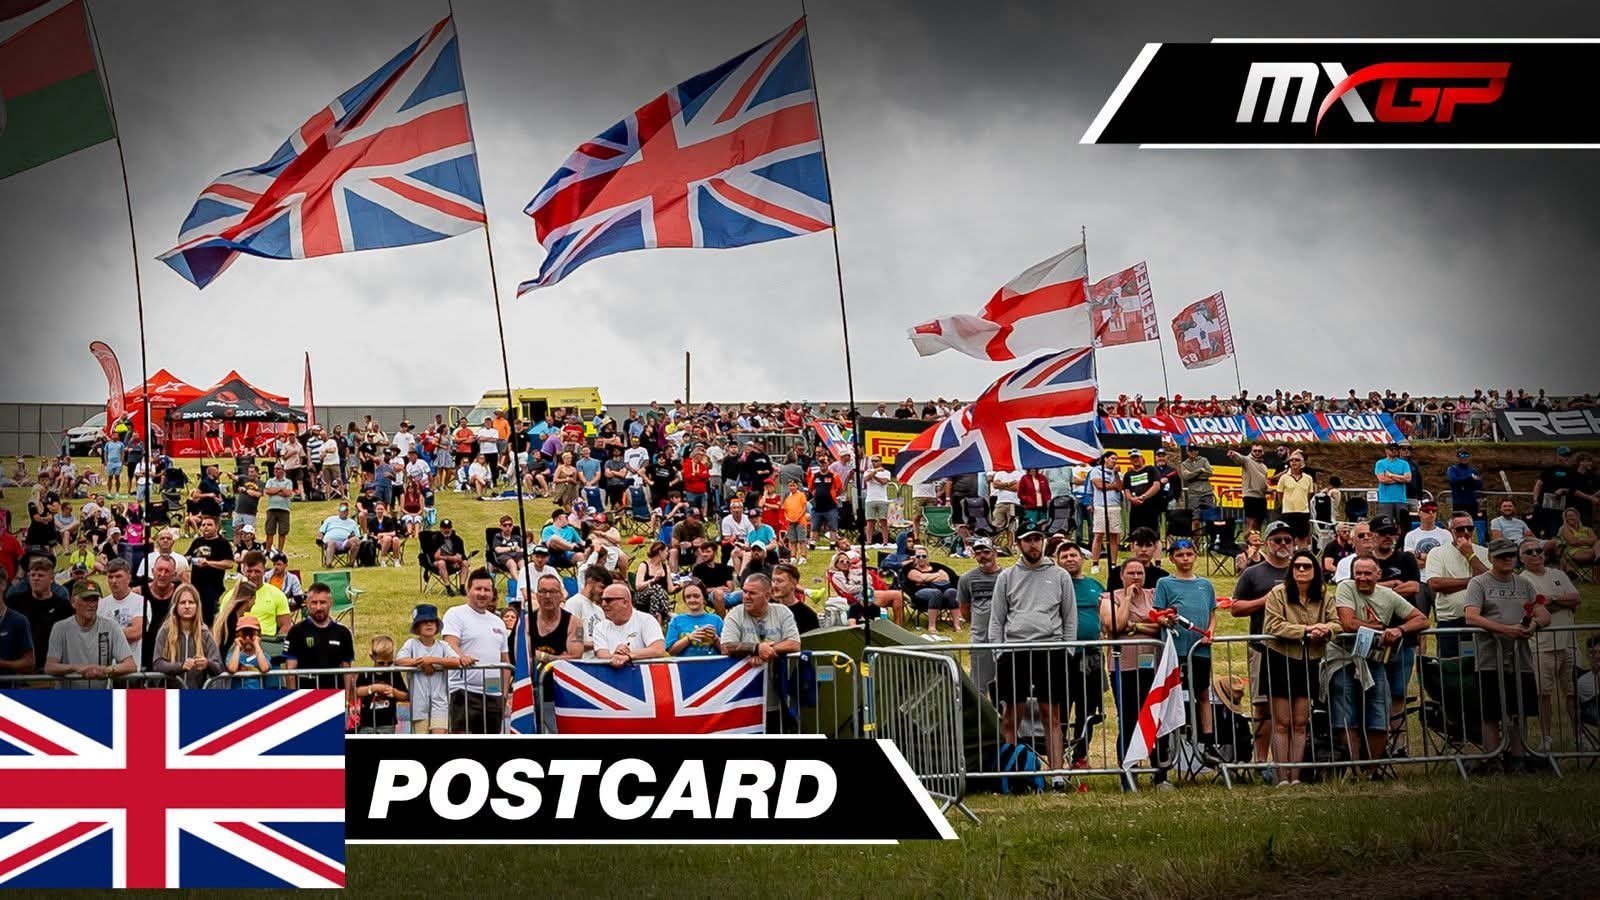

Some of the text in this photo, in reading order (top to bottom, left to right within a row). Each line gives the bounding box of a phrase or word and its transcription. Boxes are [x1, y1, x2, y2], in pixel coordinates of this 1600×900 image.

[1113, 418, 1162, 434] LIQ
[1186, 417, 1238, 433] LIQUI
[1256, 415, 1309, 431] LIQUI
[1327, 415, 1381, 431] LIQUI
[1336, 432, 1389, 444] MOLY
